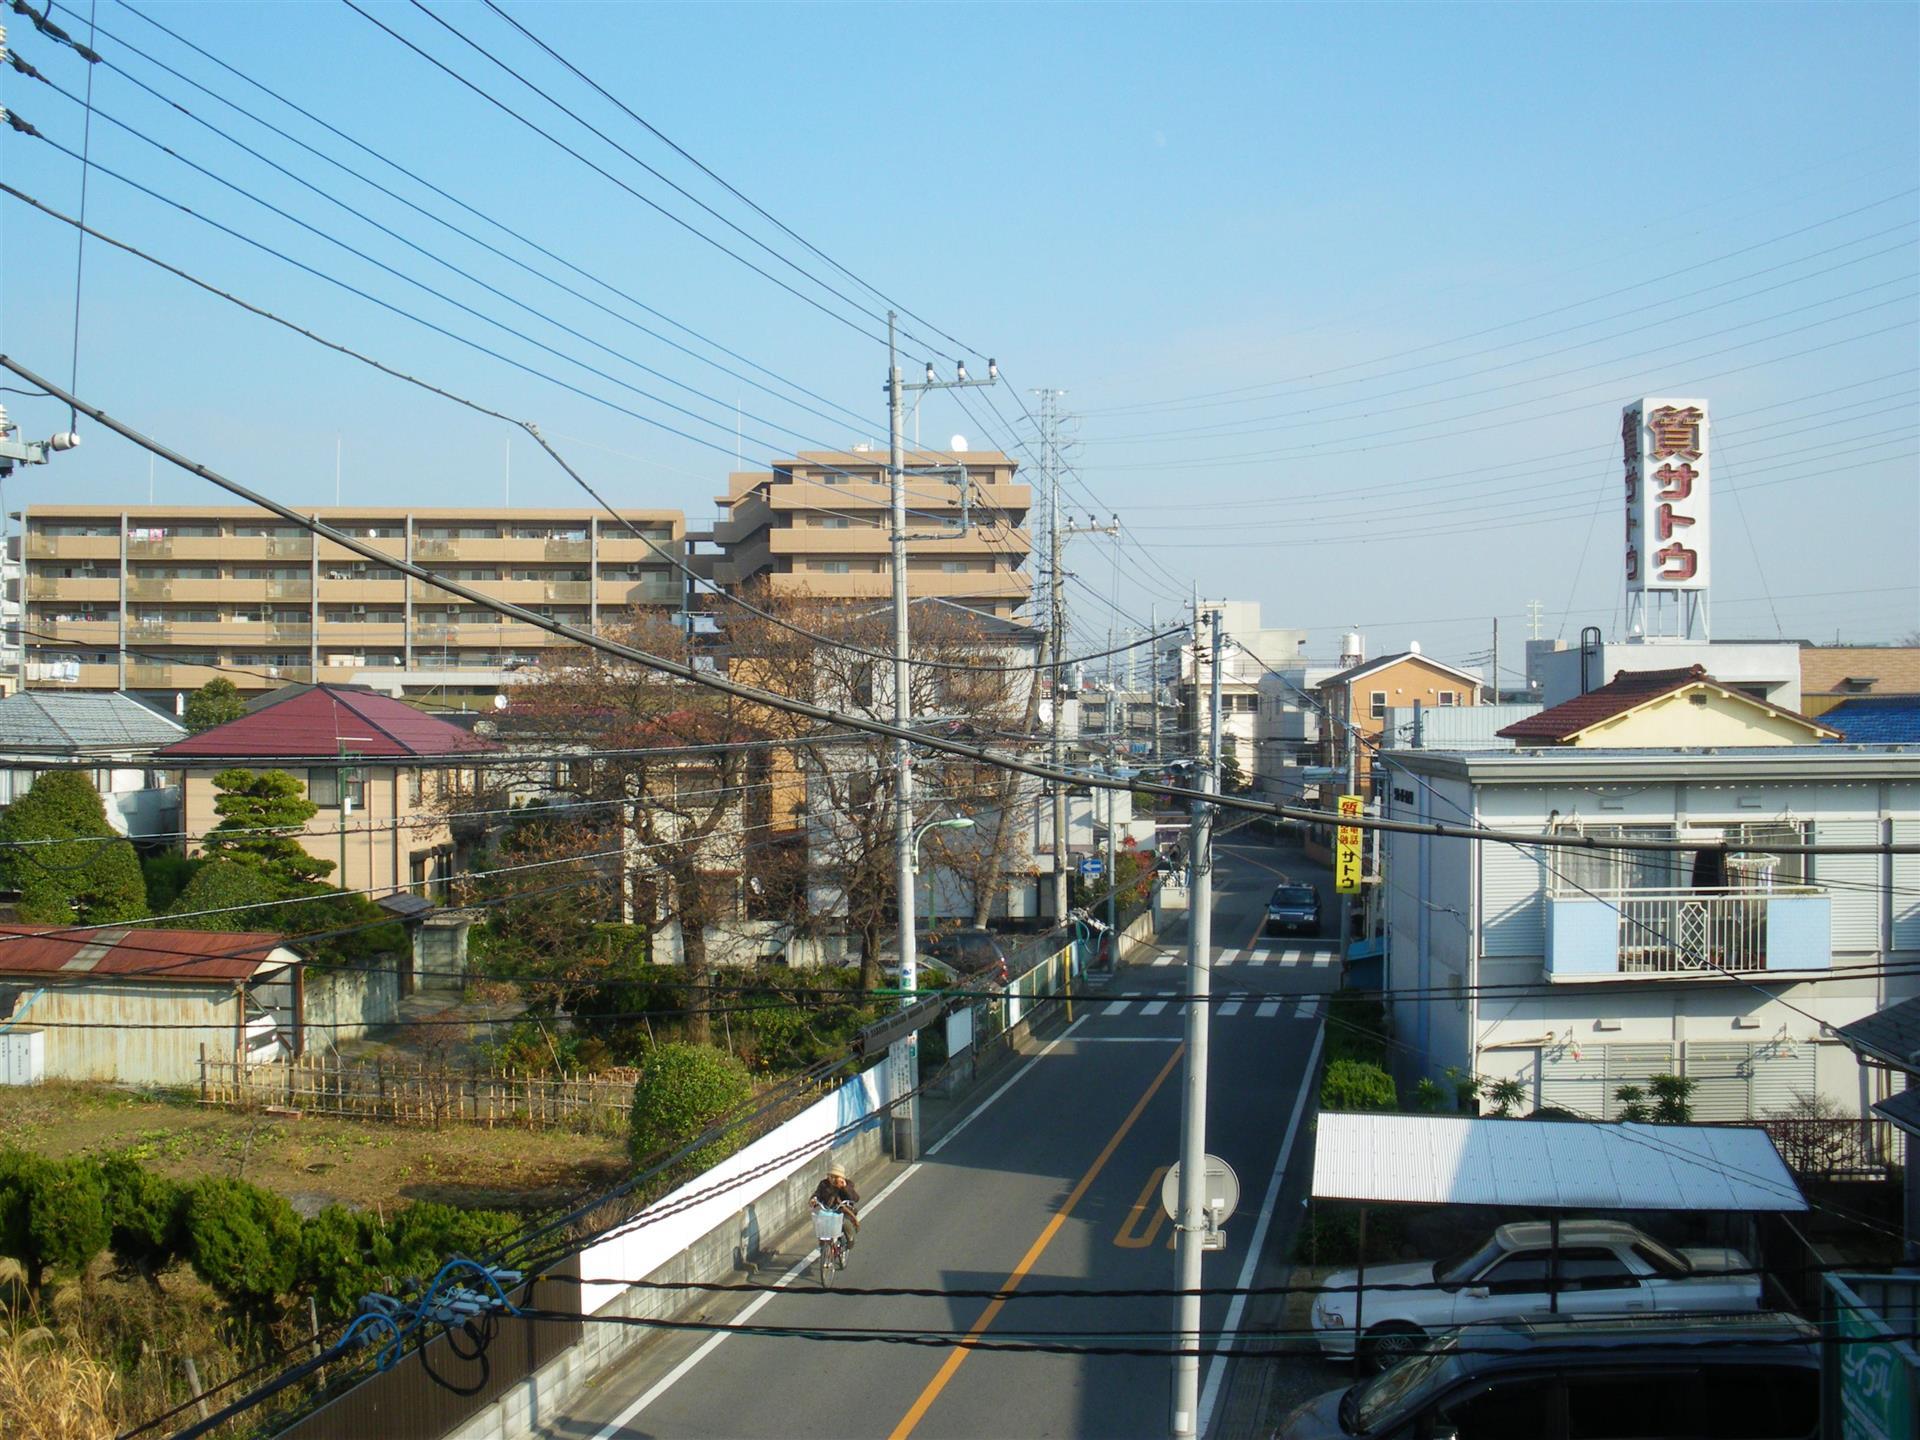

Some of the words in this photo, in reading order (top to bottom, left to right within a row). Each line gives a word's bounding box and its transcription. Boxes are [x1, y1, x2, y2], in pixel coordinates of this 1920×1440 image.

[1648, 405, 1704, 581] 質サトウ
[1342, 850, 1355, 889] サトウ
